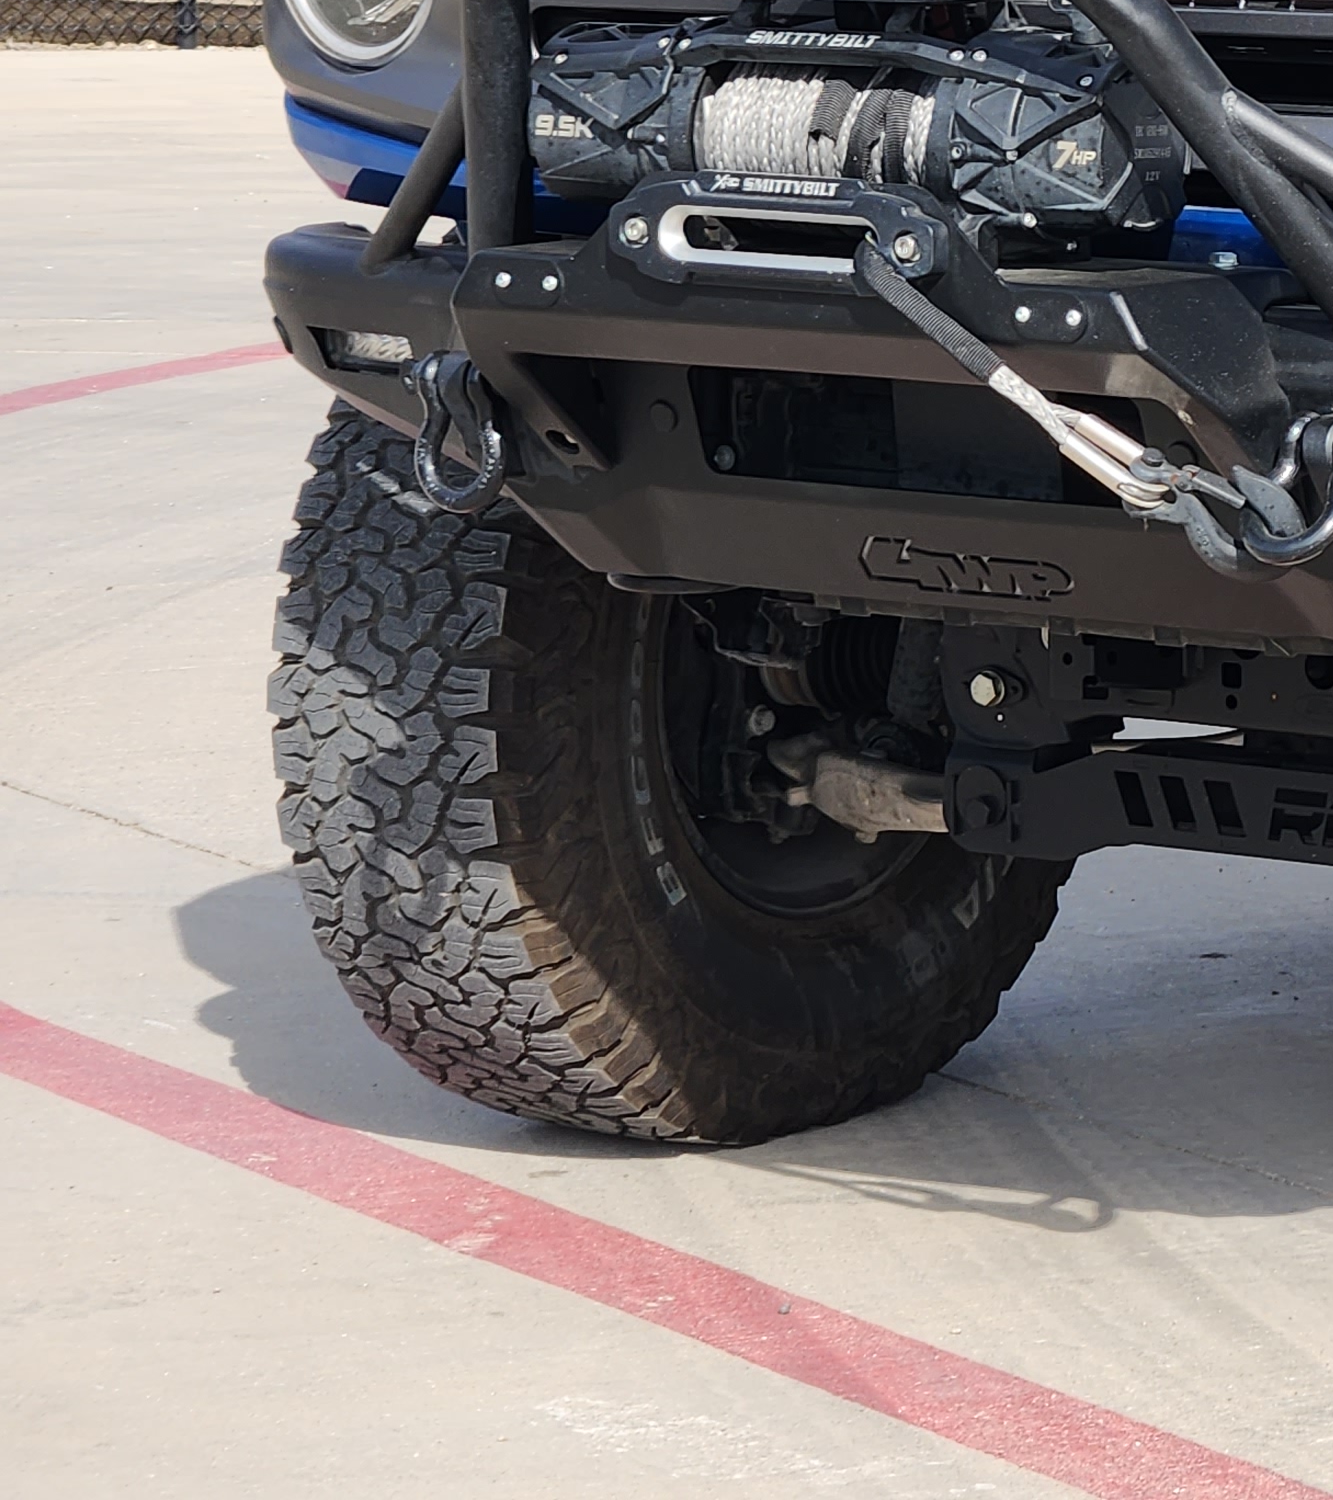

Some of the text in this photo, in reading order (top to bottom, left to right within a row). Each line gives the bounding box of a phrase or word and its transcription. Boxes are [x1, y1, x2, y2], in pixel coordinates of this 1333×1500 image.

[745, 30, 881, 48] SMITTYBILT
[534, 114, 595, 139] 9.5K
[741, 177, 841, 197] SMITTYBILT
